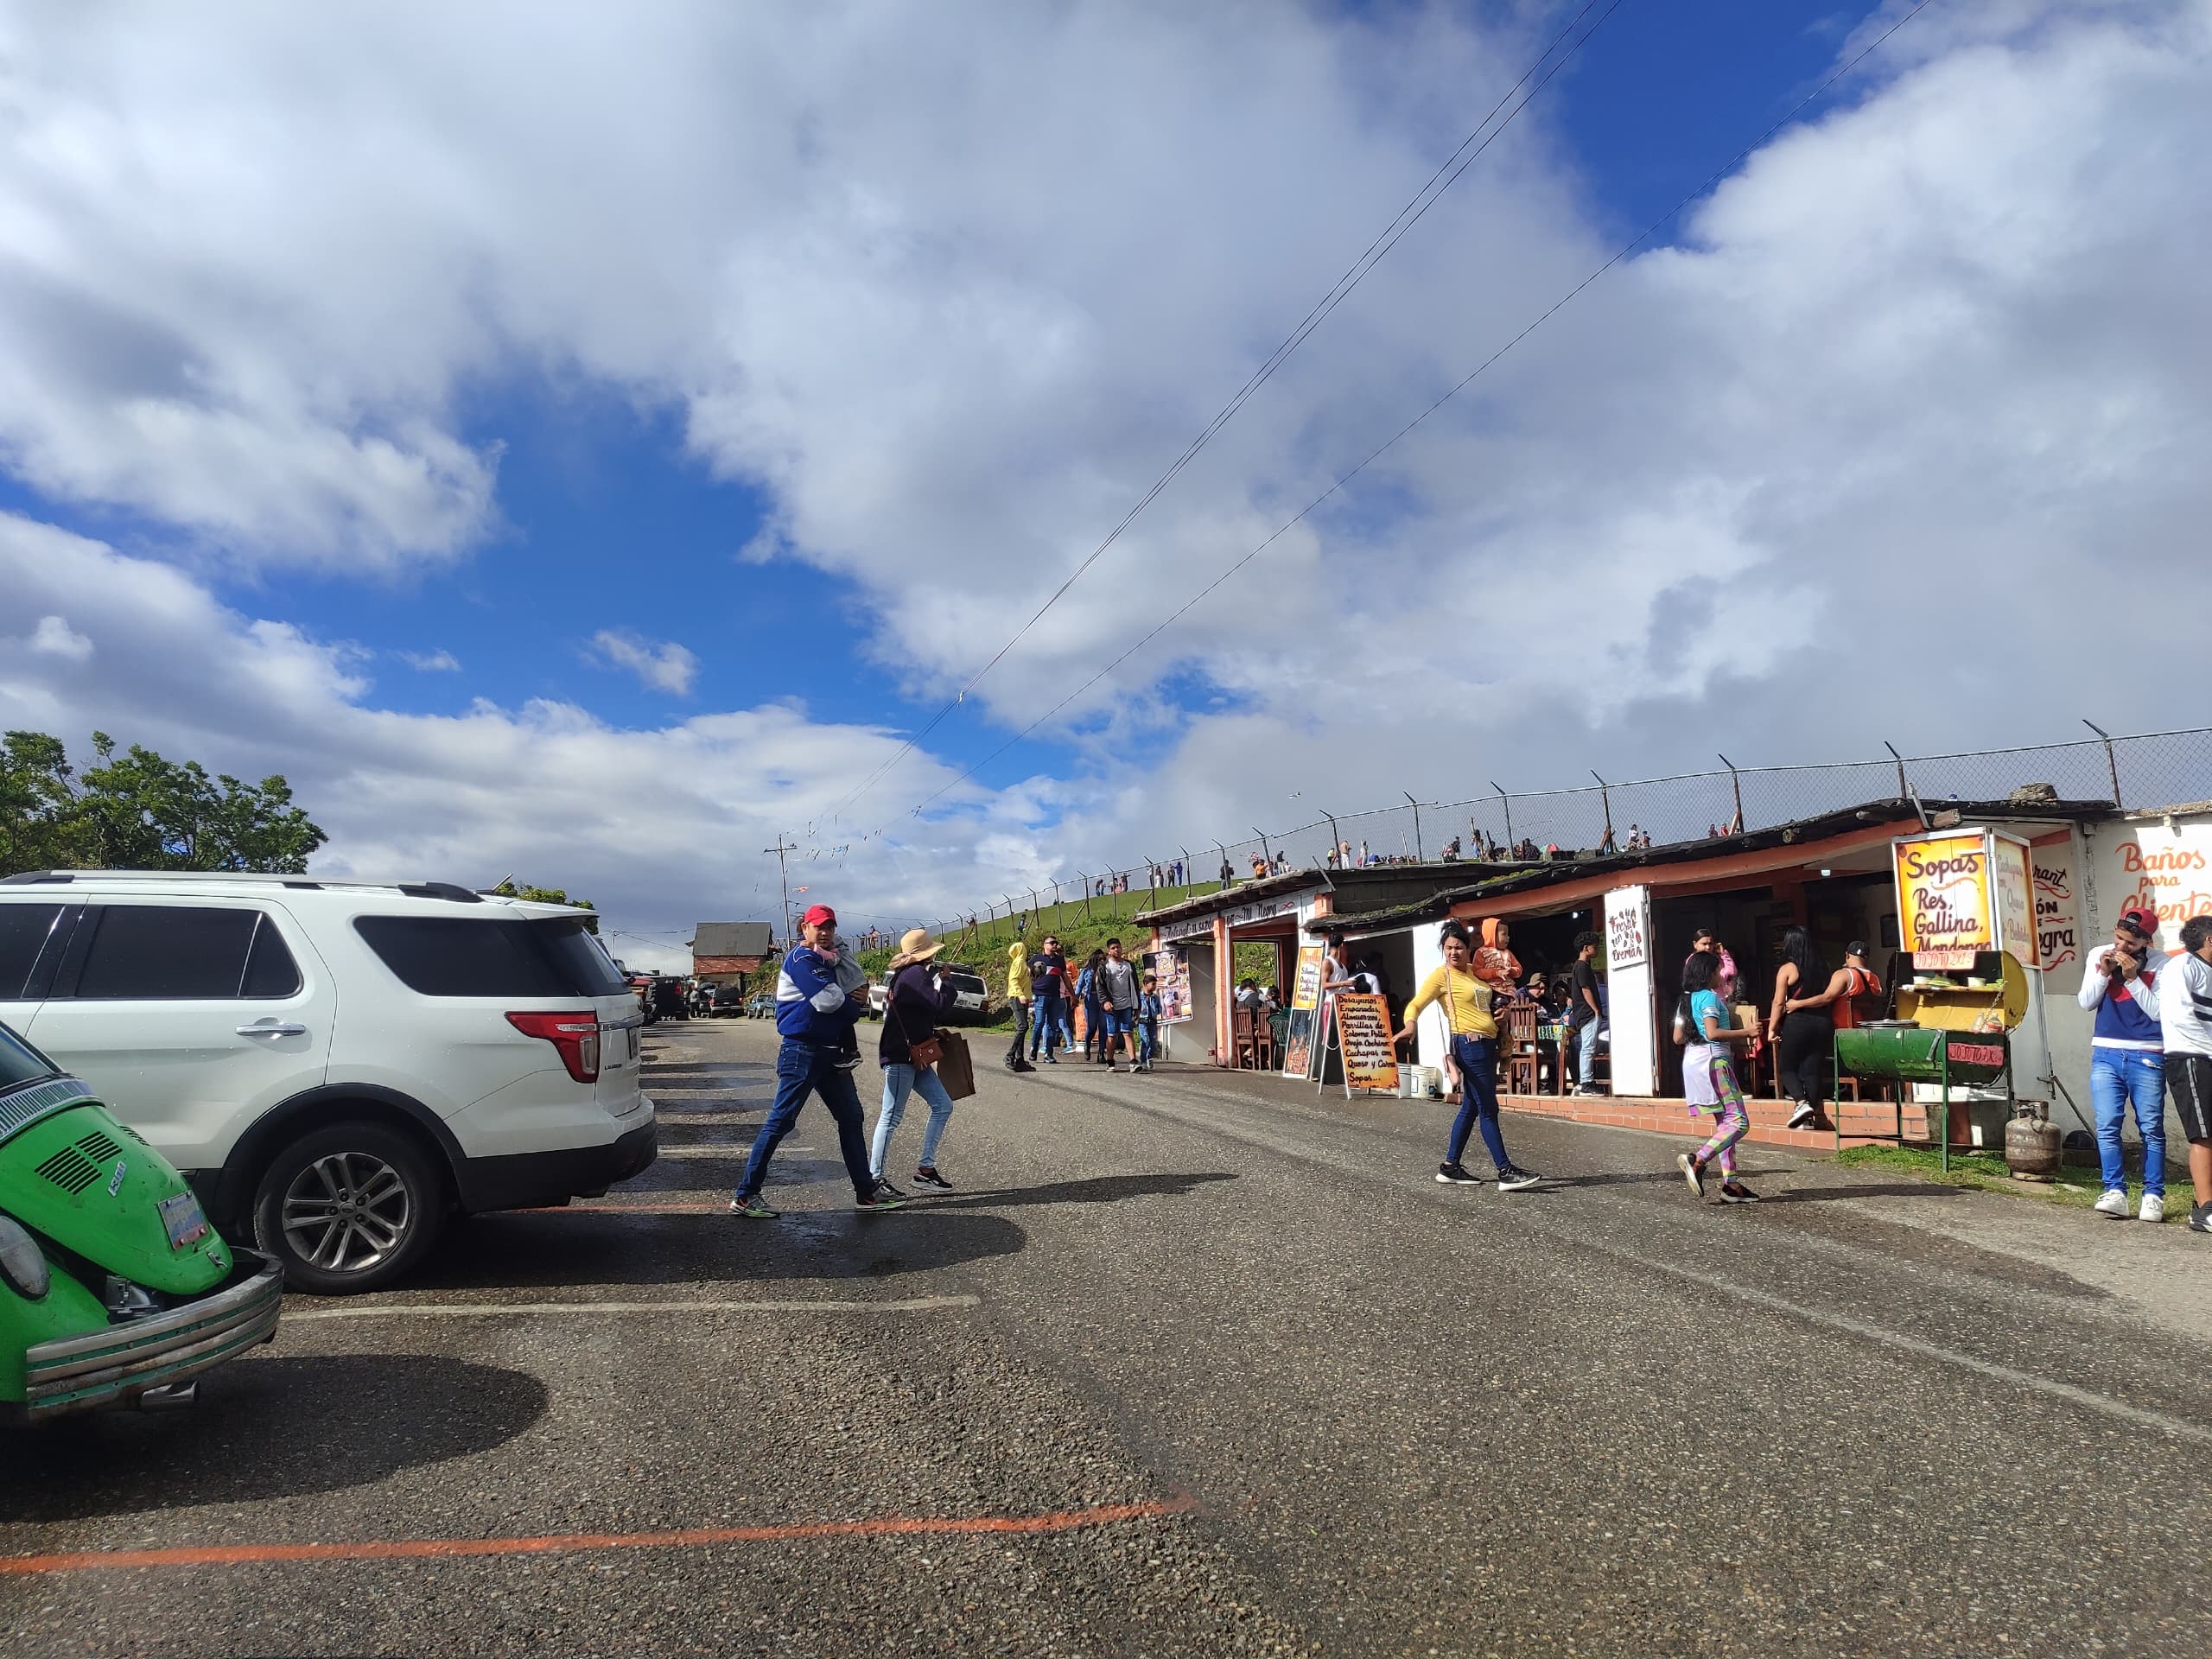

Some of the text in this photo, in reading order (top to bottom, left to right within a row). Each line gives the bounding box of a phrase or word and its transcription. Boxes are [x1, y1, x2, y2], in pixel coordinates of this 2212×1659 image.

[1906, 851, 1979, 883] Sopas
[2115, 842, 2205, 872] Baños
[2139, 874, 2180, 893] para
[1913, 887, 1953, 910] Res,
[2120, 890, 2212, 922] Cliente
[1913, 911, 1983, 935] Gallina,
[1345, 1049, 1379, 1058] Cachapas
[1348, 1058, 1369, 1069] Queso
[1371, 1059, 1376, 1070] y
